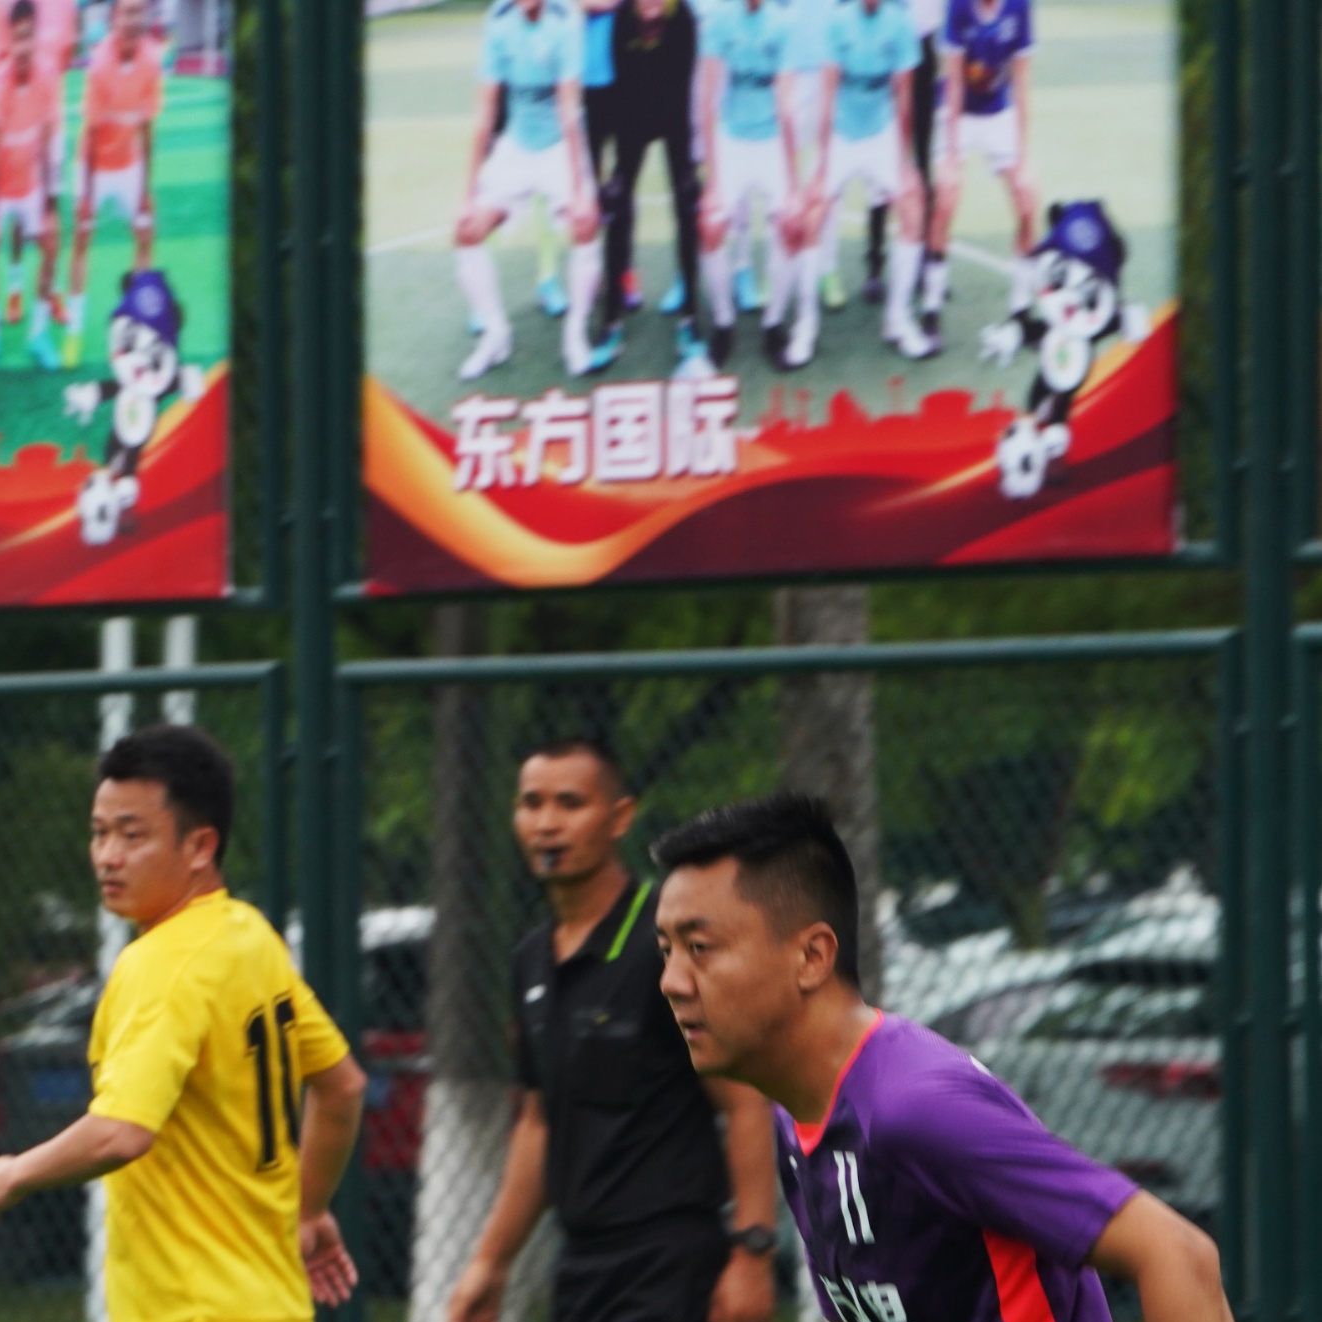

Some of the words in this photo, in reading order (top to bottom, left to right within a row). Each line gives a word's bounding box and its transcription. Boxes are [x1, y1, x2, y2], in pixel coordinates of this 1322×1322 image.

[452, 376, 738, 490] 东方国际
[833, 1150, 876, 1245] 11
